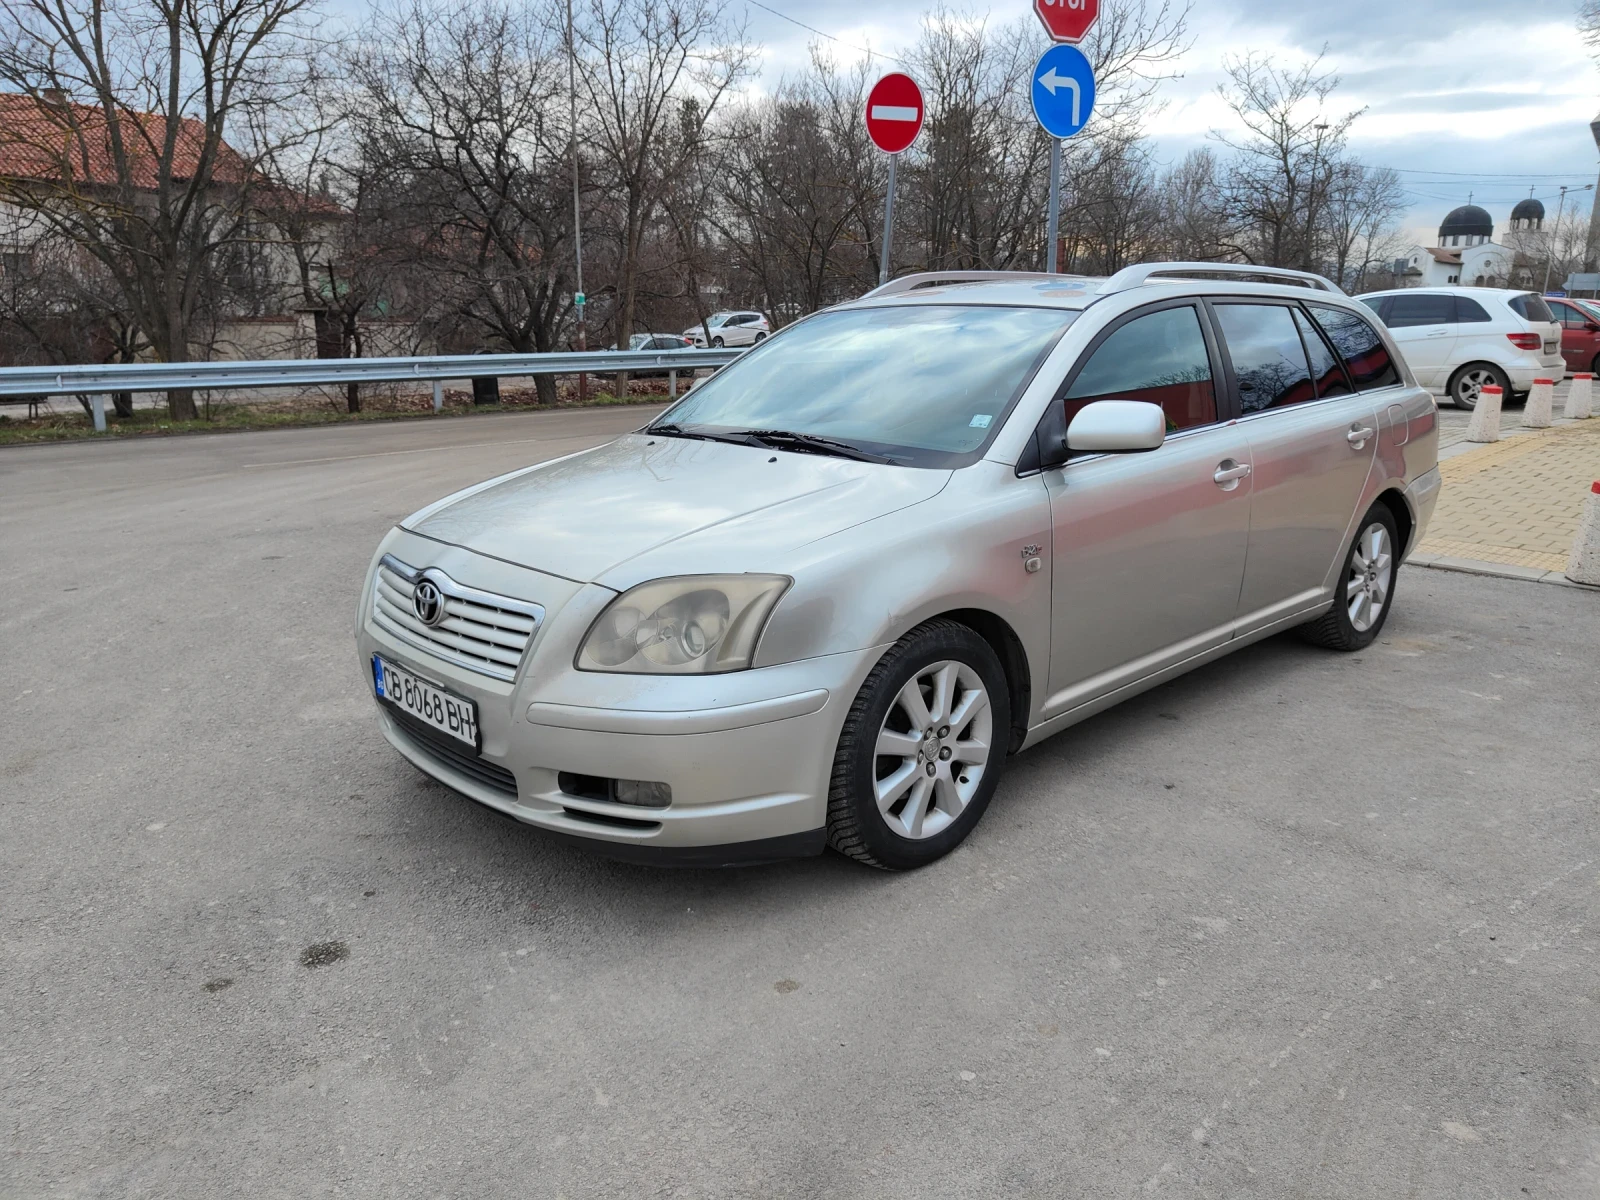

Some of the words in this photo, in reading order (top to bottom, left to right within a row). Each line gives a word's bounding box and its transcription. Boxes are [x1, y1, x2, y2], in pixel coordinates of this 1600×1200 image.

[383, 666, 402, 702] CB
[404, 678, 444, 724] 8068
[445, 699, 473, 740] BH
